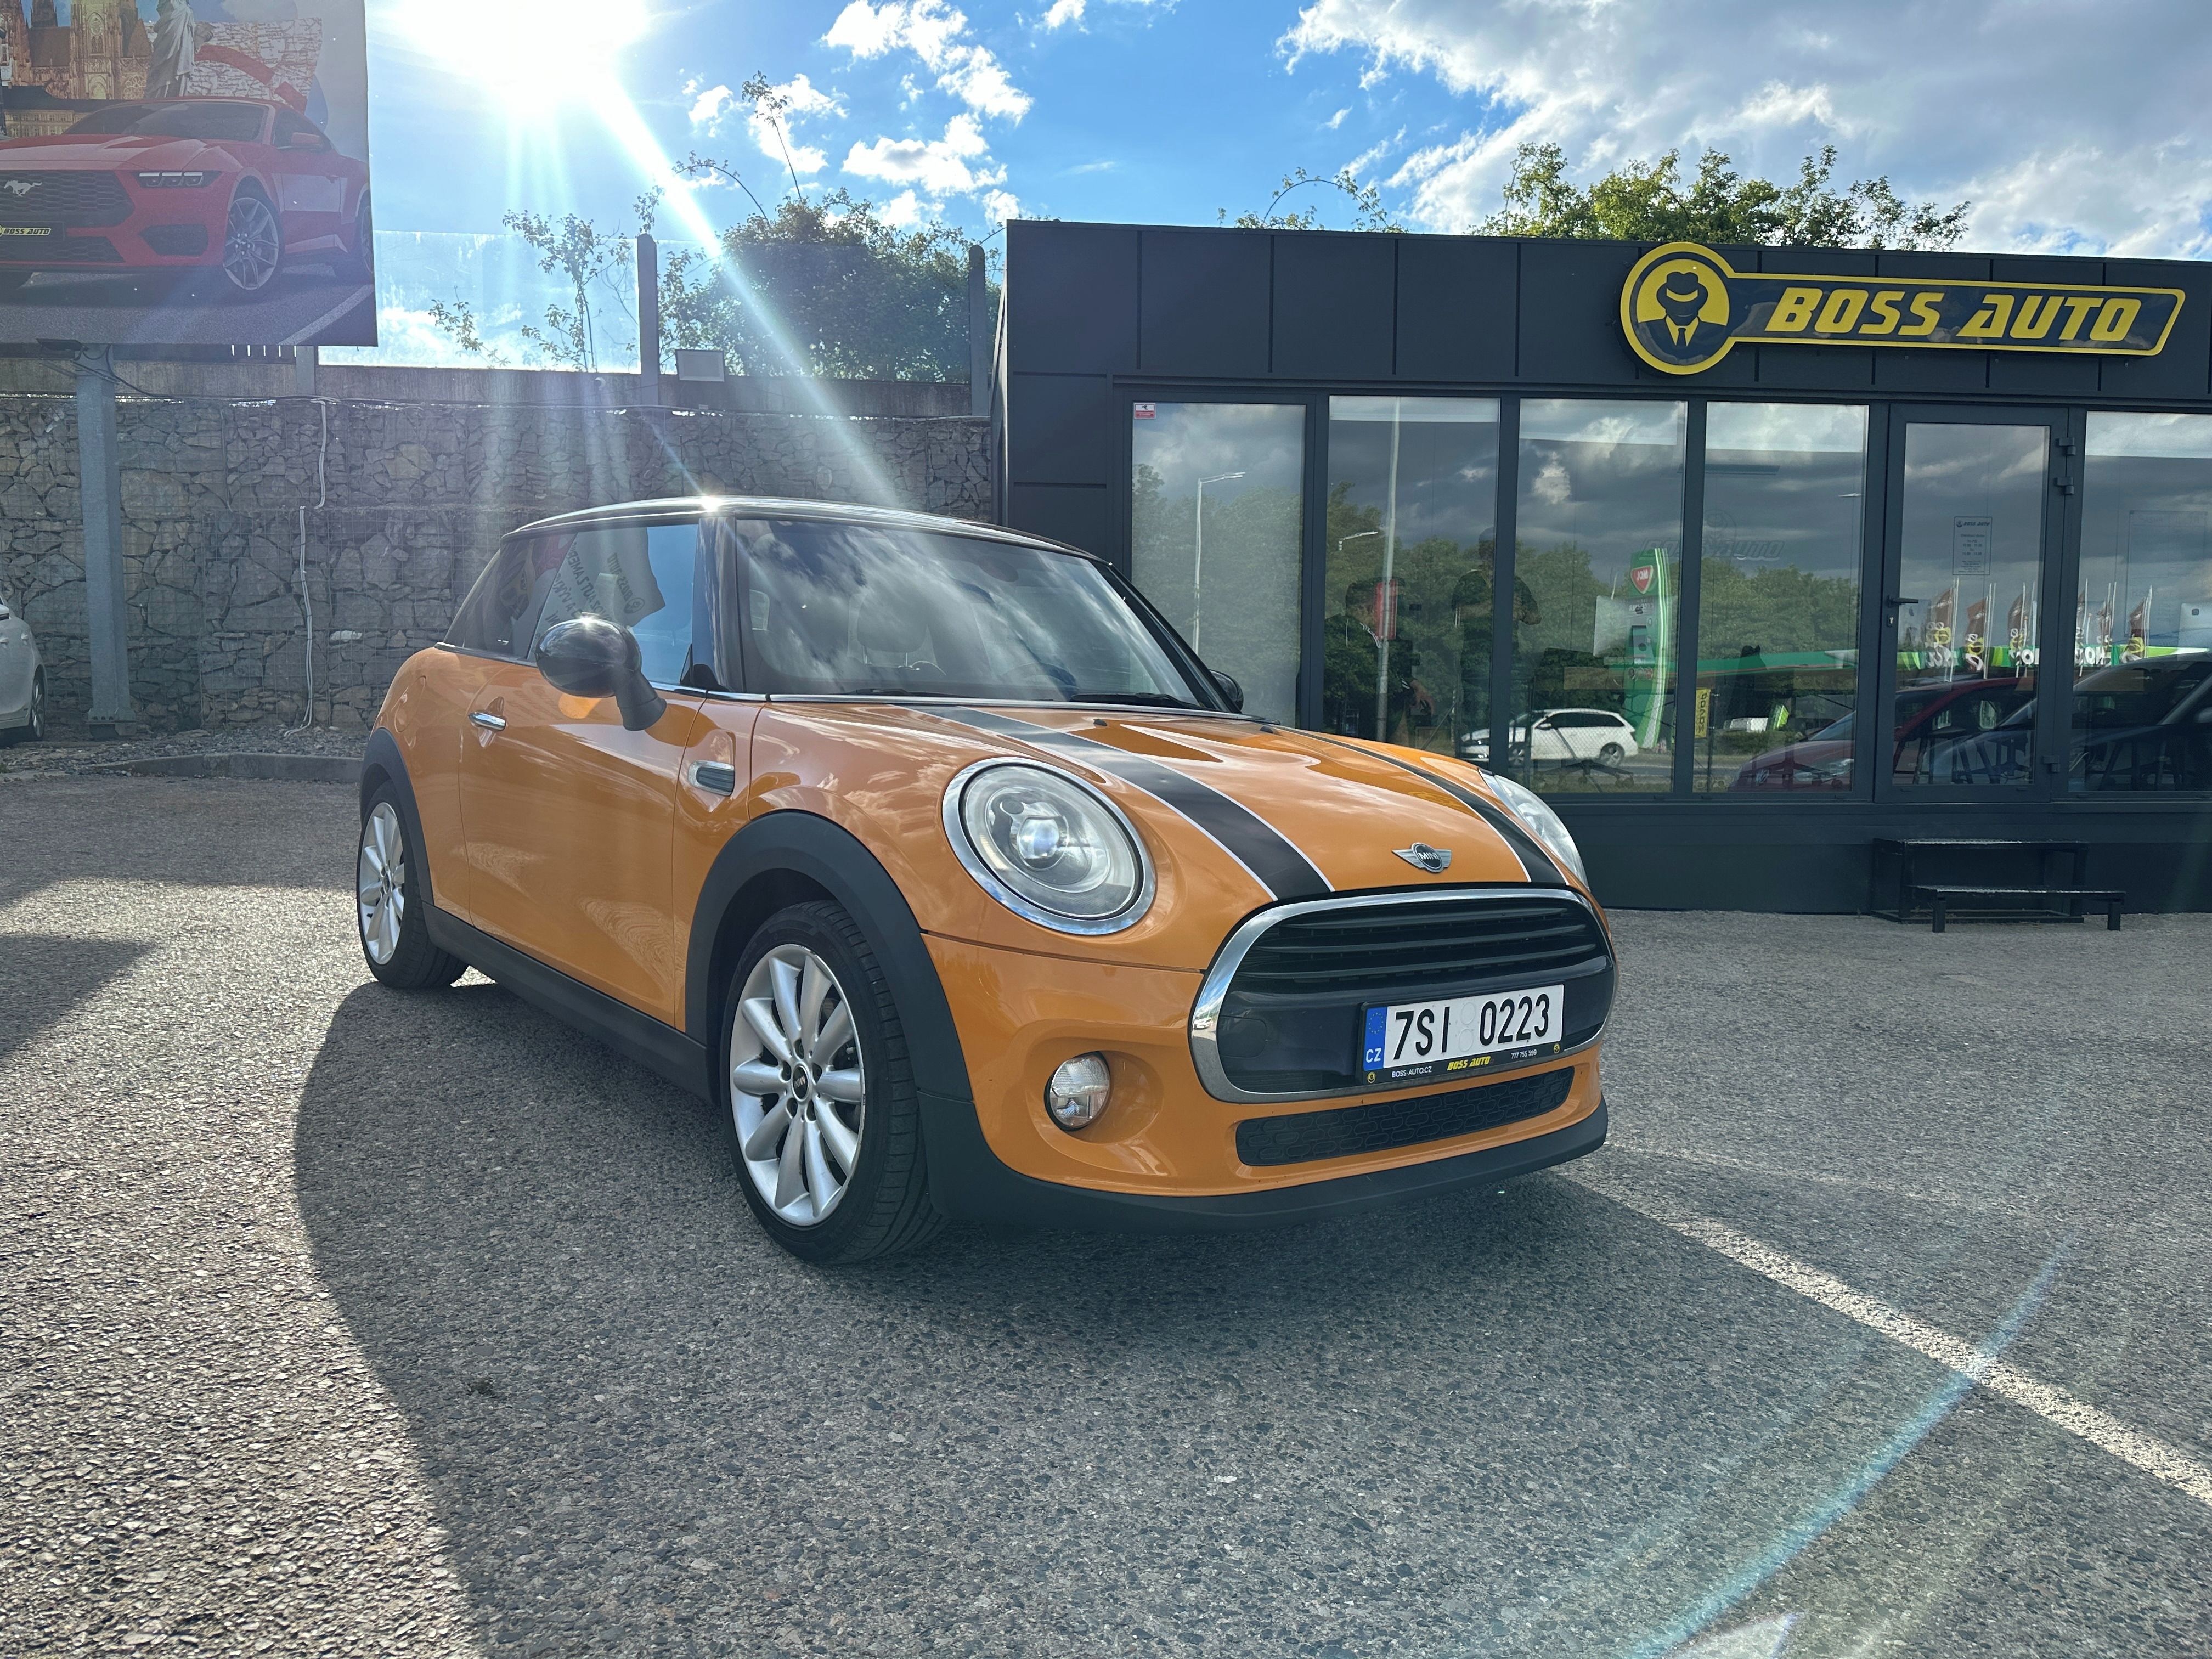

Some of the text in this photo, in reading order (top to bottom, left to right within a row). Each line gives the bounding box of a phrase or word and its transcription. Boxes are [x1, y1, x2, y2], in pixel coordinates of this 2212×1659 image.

[1764, 287, 2142, 342] BOSS AUTO
[1418, 852, 1440, 860] MINI
[1393, 993, 1550, 1060] 7SI 0223
[1365, 1048, 1381, 1064] CZ
[1447, 1056, 1491, 1071] BOSS AUTO
[1392, 1066, 1432, 1078] BOSS-AUTO.CZ
